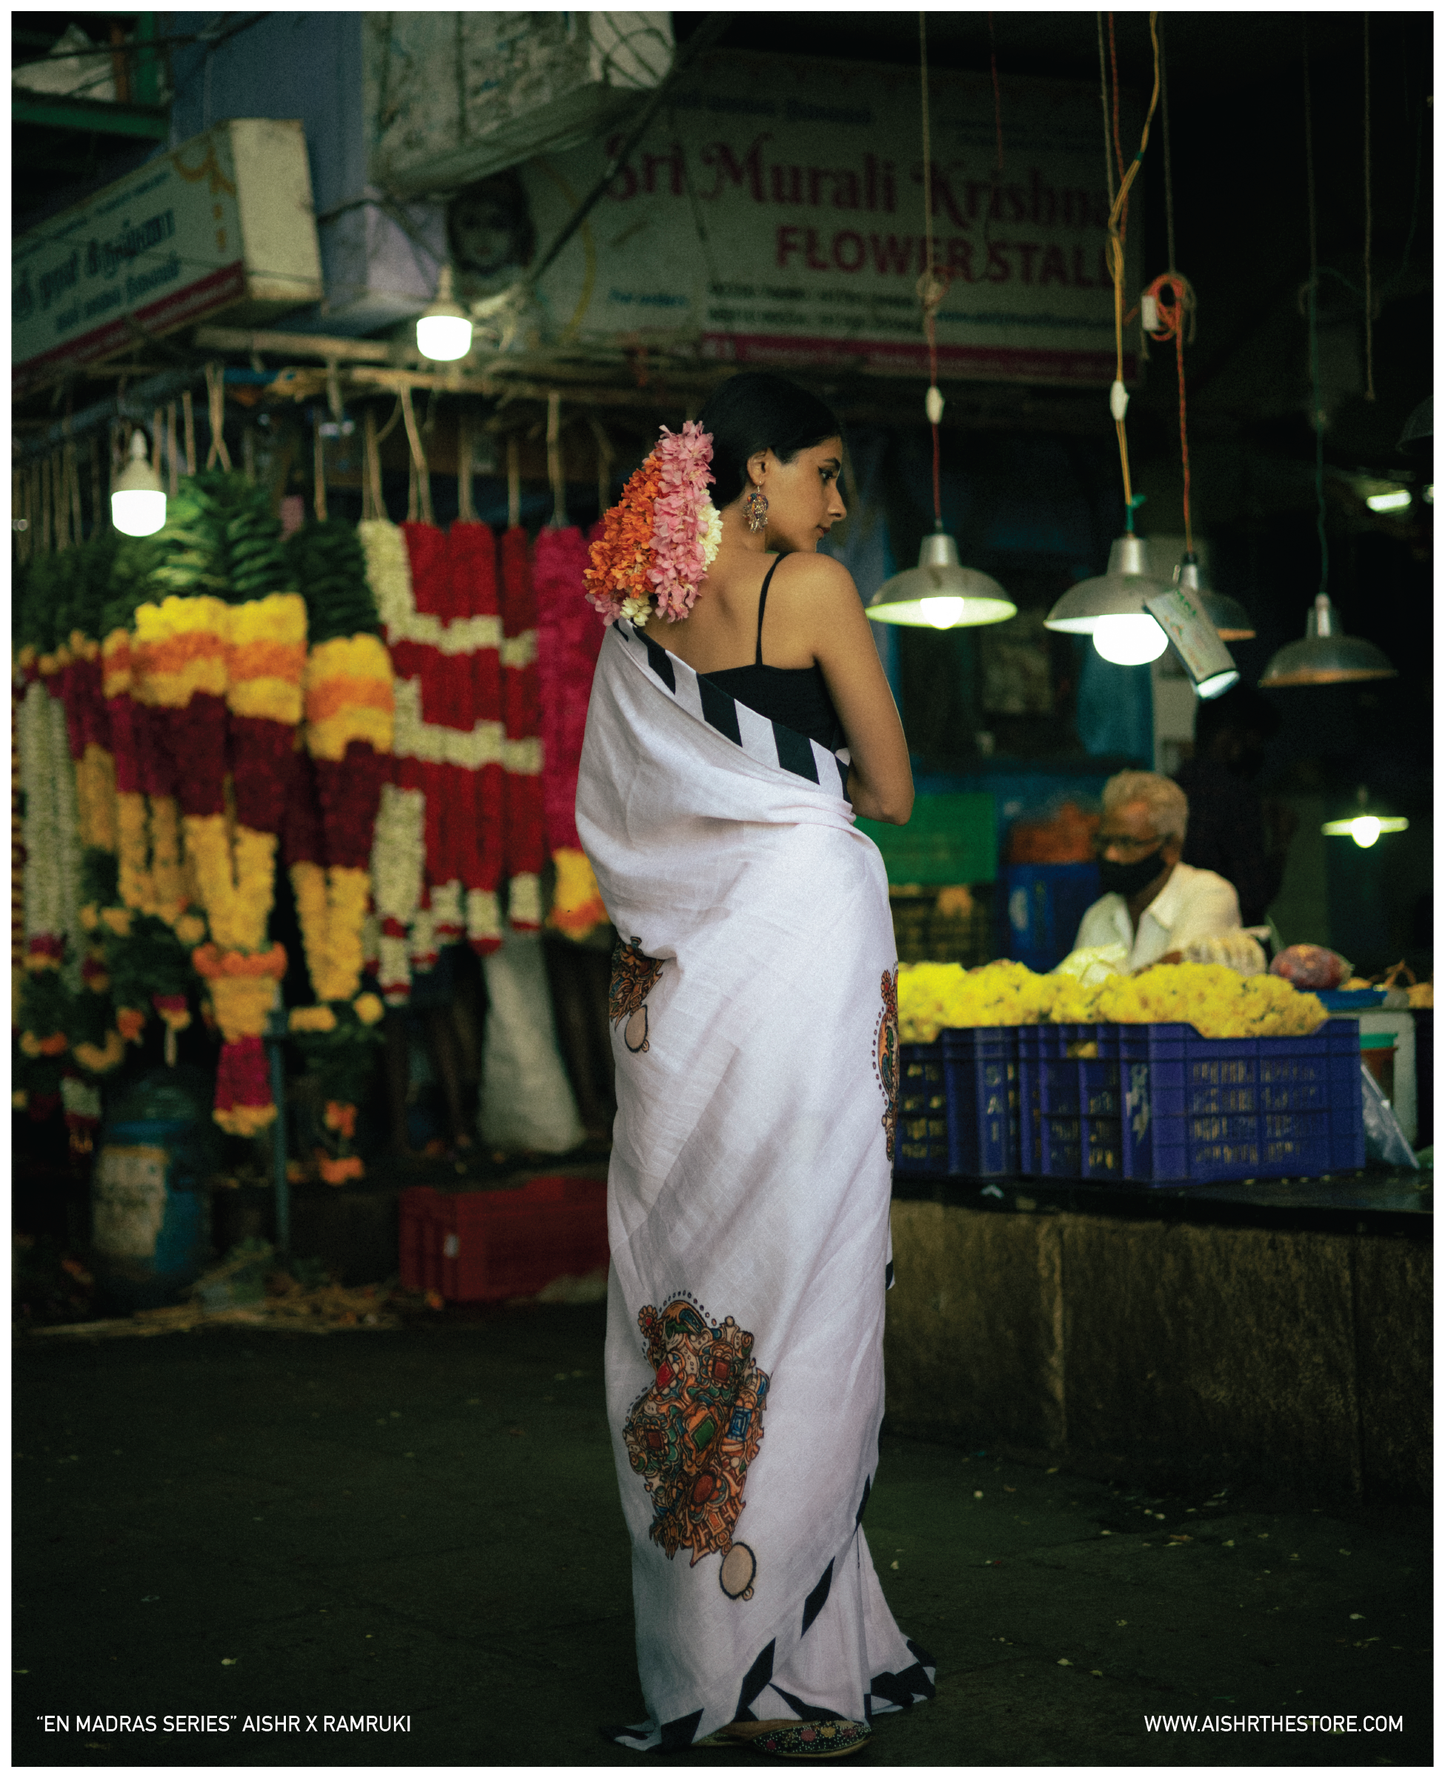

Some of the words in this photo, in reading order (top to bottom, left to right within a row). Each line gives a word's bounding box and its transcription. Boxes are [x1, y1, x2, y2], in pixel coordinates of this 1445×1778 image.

[606, 132, 683, 201] Sri
[700, 132, 897, 214] Murali
[777, 224, 976, 282] FLOWER
[987, 241, 1115, 289] STALL
